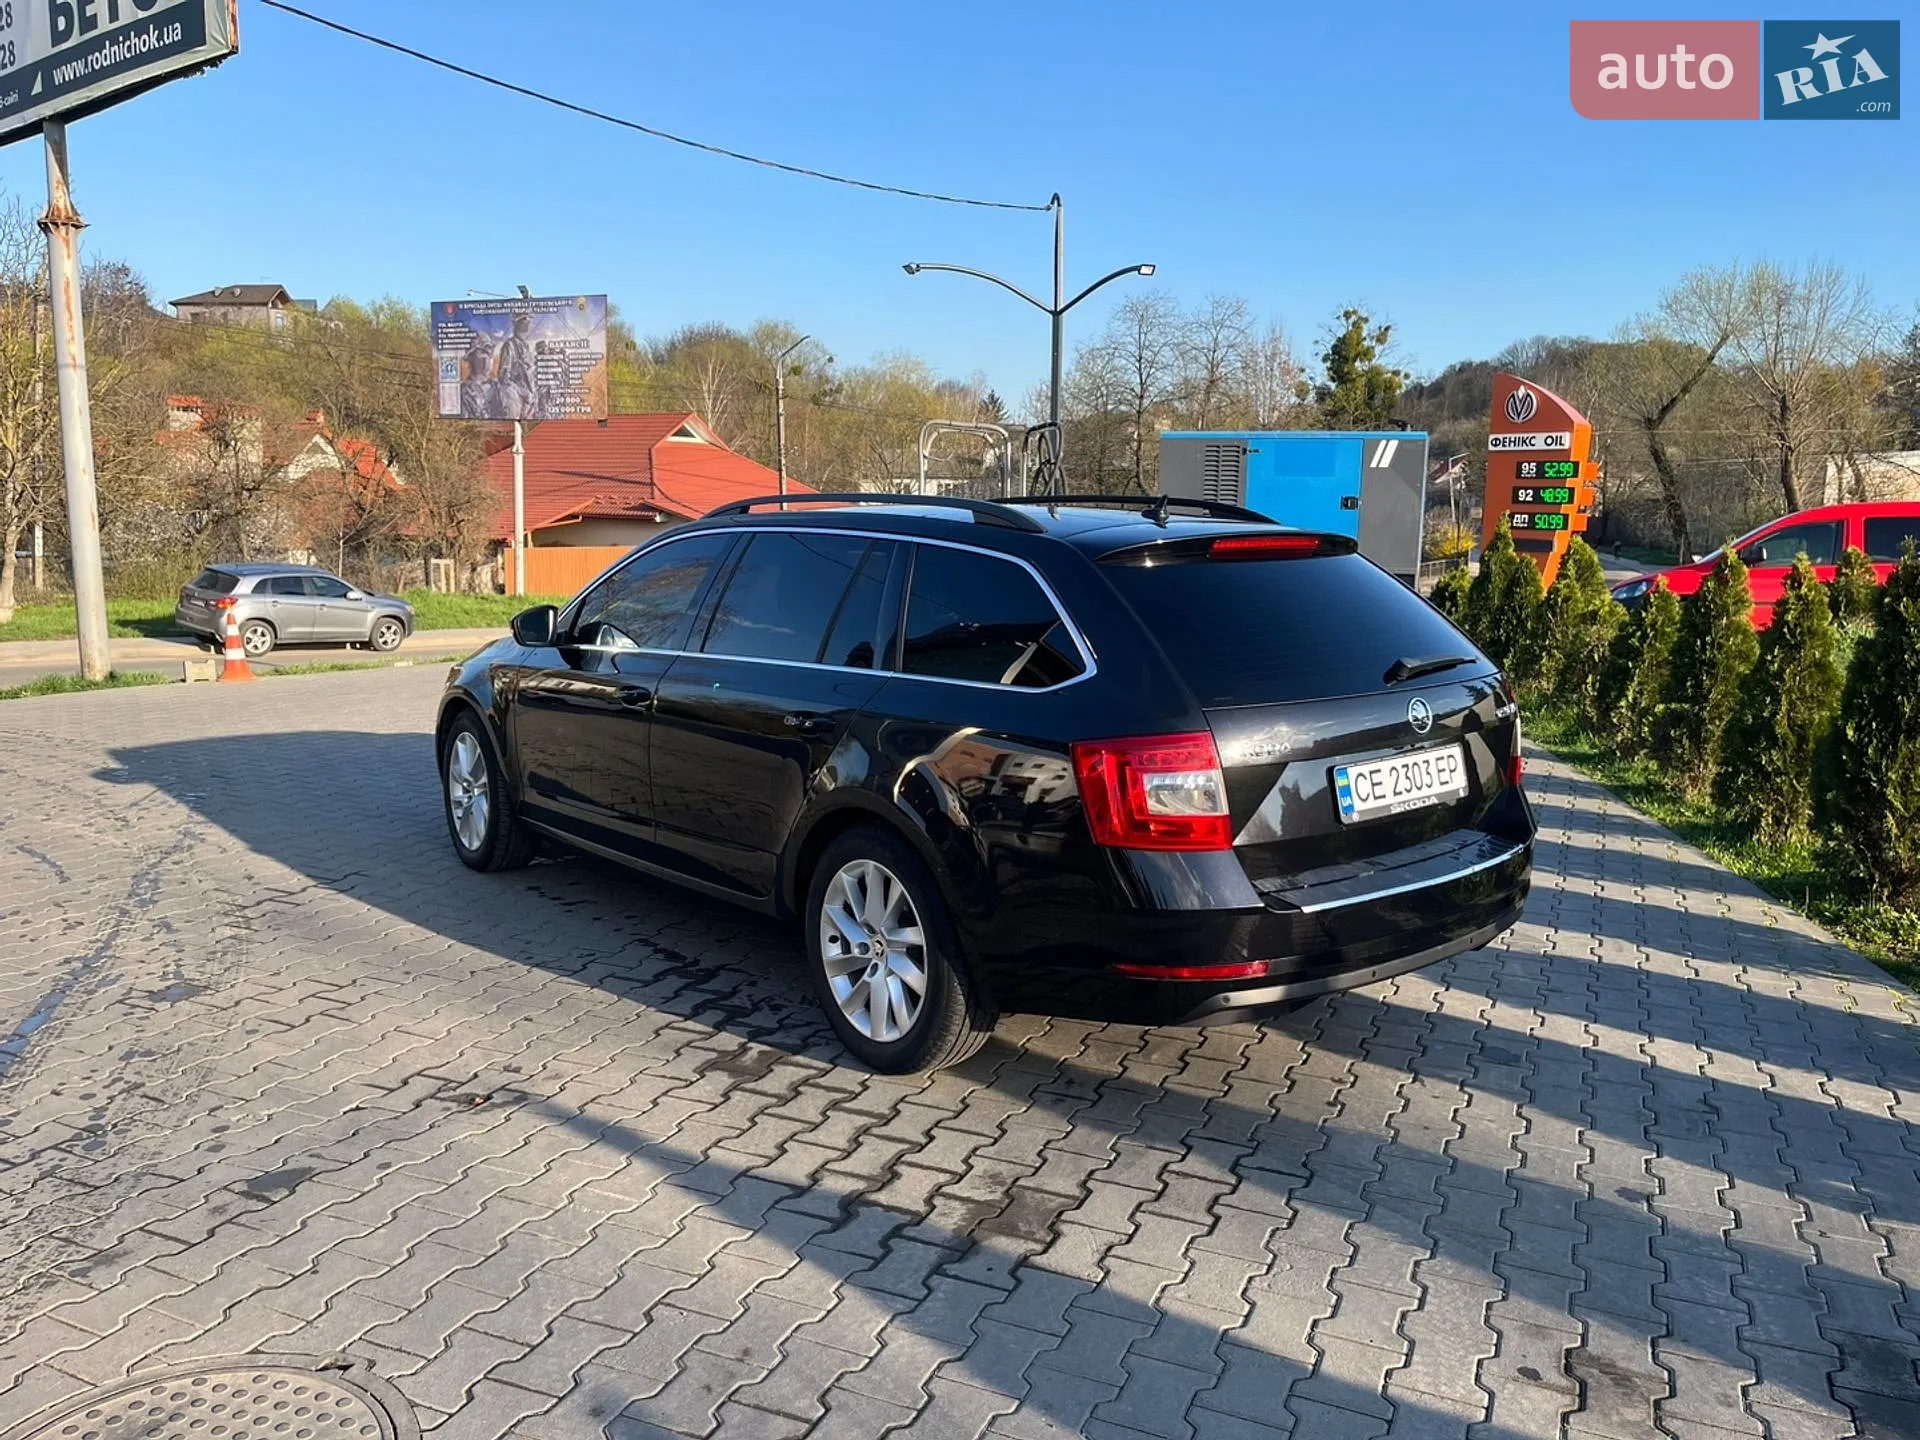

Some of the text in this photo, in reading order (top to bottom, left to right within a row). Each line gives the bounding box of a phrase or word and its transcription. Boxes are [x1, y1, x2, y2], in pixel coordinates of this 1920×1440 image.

[53, 22, 182, 86] www.rodnichok.ua
[1490, 435, 1565, 448] ФЕНІКС OIL
[1521, 462, 1537, 473] 95
[1518, 489, 1534, 501] 92
[1514, 514, 1528, 523] ДП
[1354, 754, 1458, 803] CE 2303 EP
